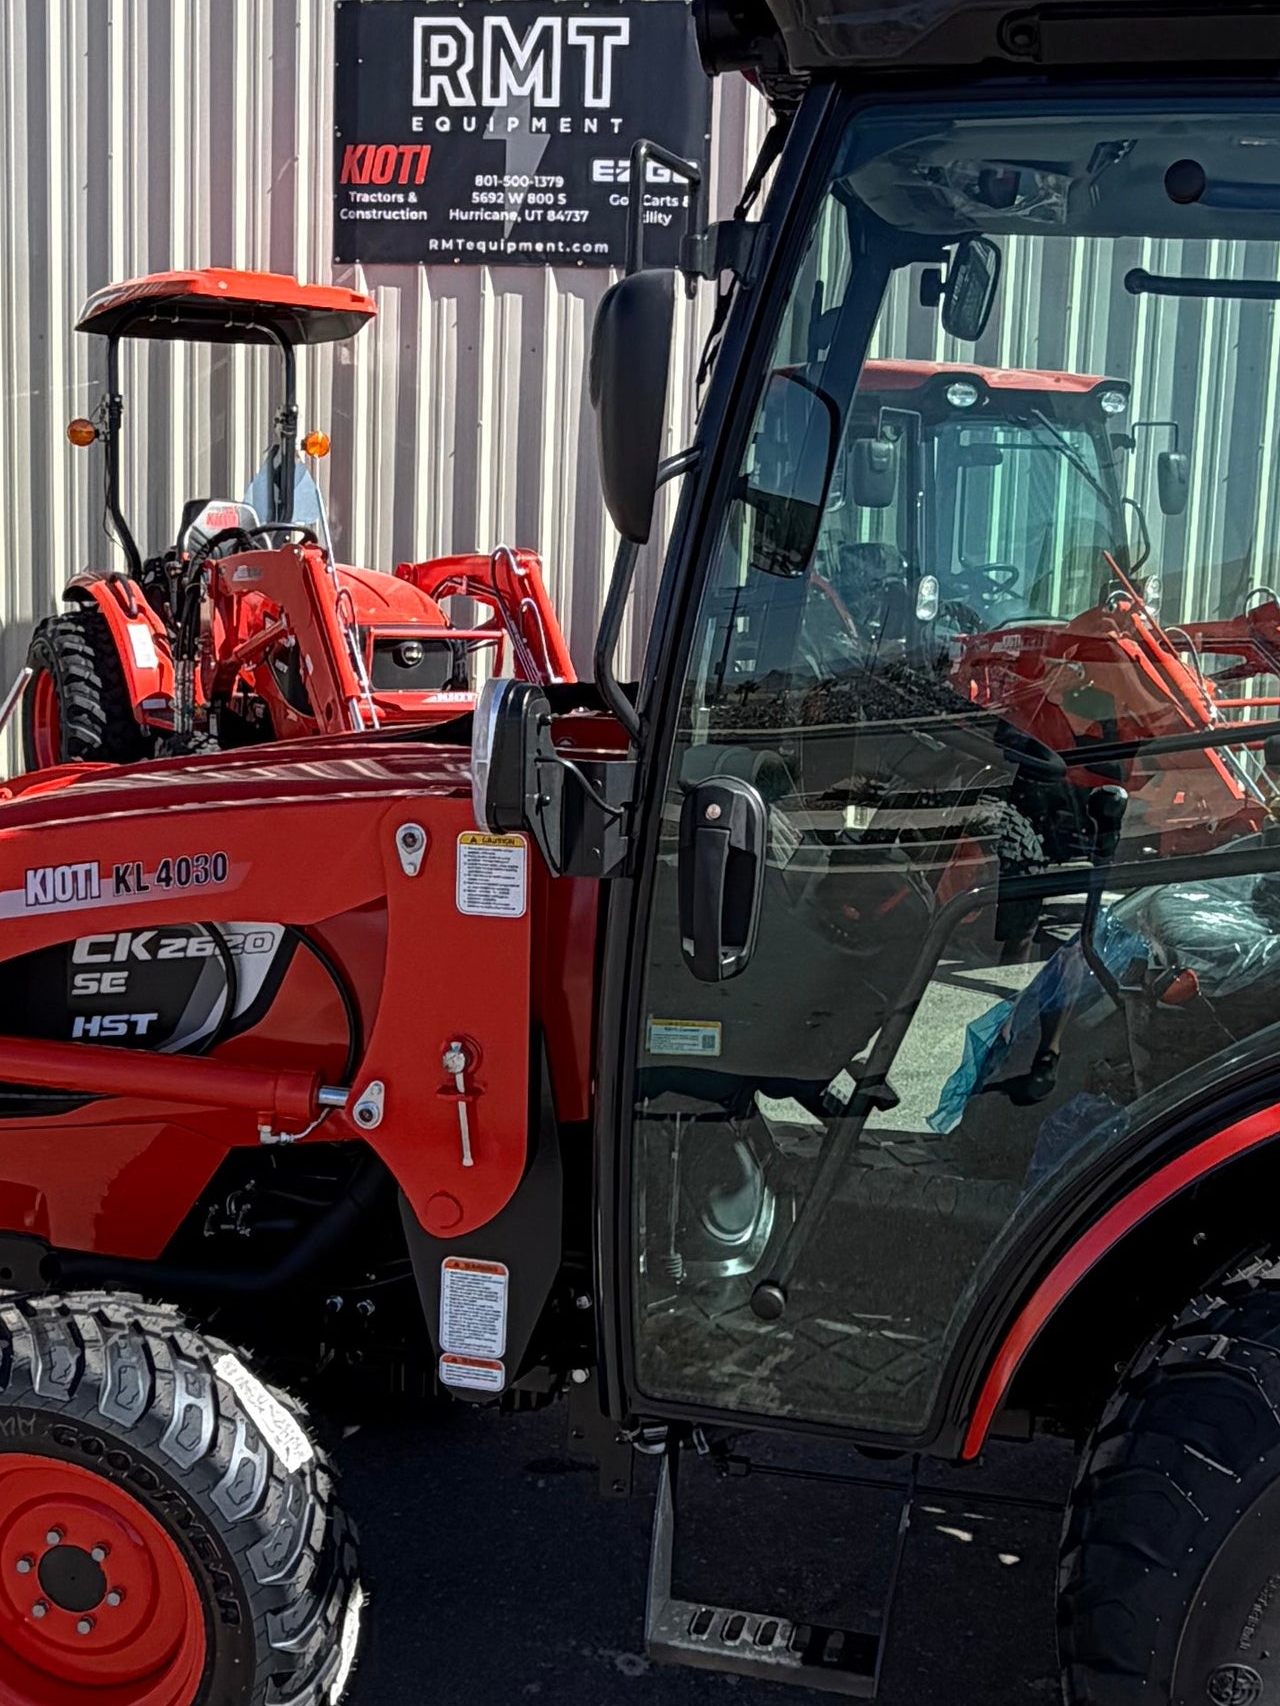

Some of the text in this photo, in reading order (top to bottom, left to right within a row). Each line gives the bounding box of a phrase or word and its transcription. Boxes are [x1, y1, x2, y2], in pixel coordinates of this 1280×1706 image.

[412, 16, 630, 108] RMT
[412, 116, 624, 134] EQUIPMENT
[340, 144, 432, 185] KIOTI
[475, 174, 565, 188] 801-500-1379
[349, 191, 418, 204] Tractors &
[471, 192, 567, 205] 5692 W 800 S
[642, 194, 679, 207] Carts
[339, 207, 428, 221] Construction
[449, 208, 590, 223] Hurricane, UT 84737
[429, 239, 609, 254] RMTequipment.com
[25, 851, 229, 908] KIOTI KL 4030
[72, 971, 129, 995] SE
[72, 1012, 158, 1038] HST
